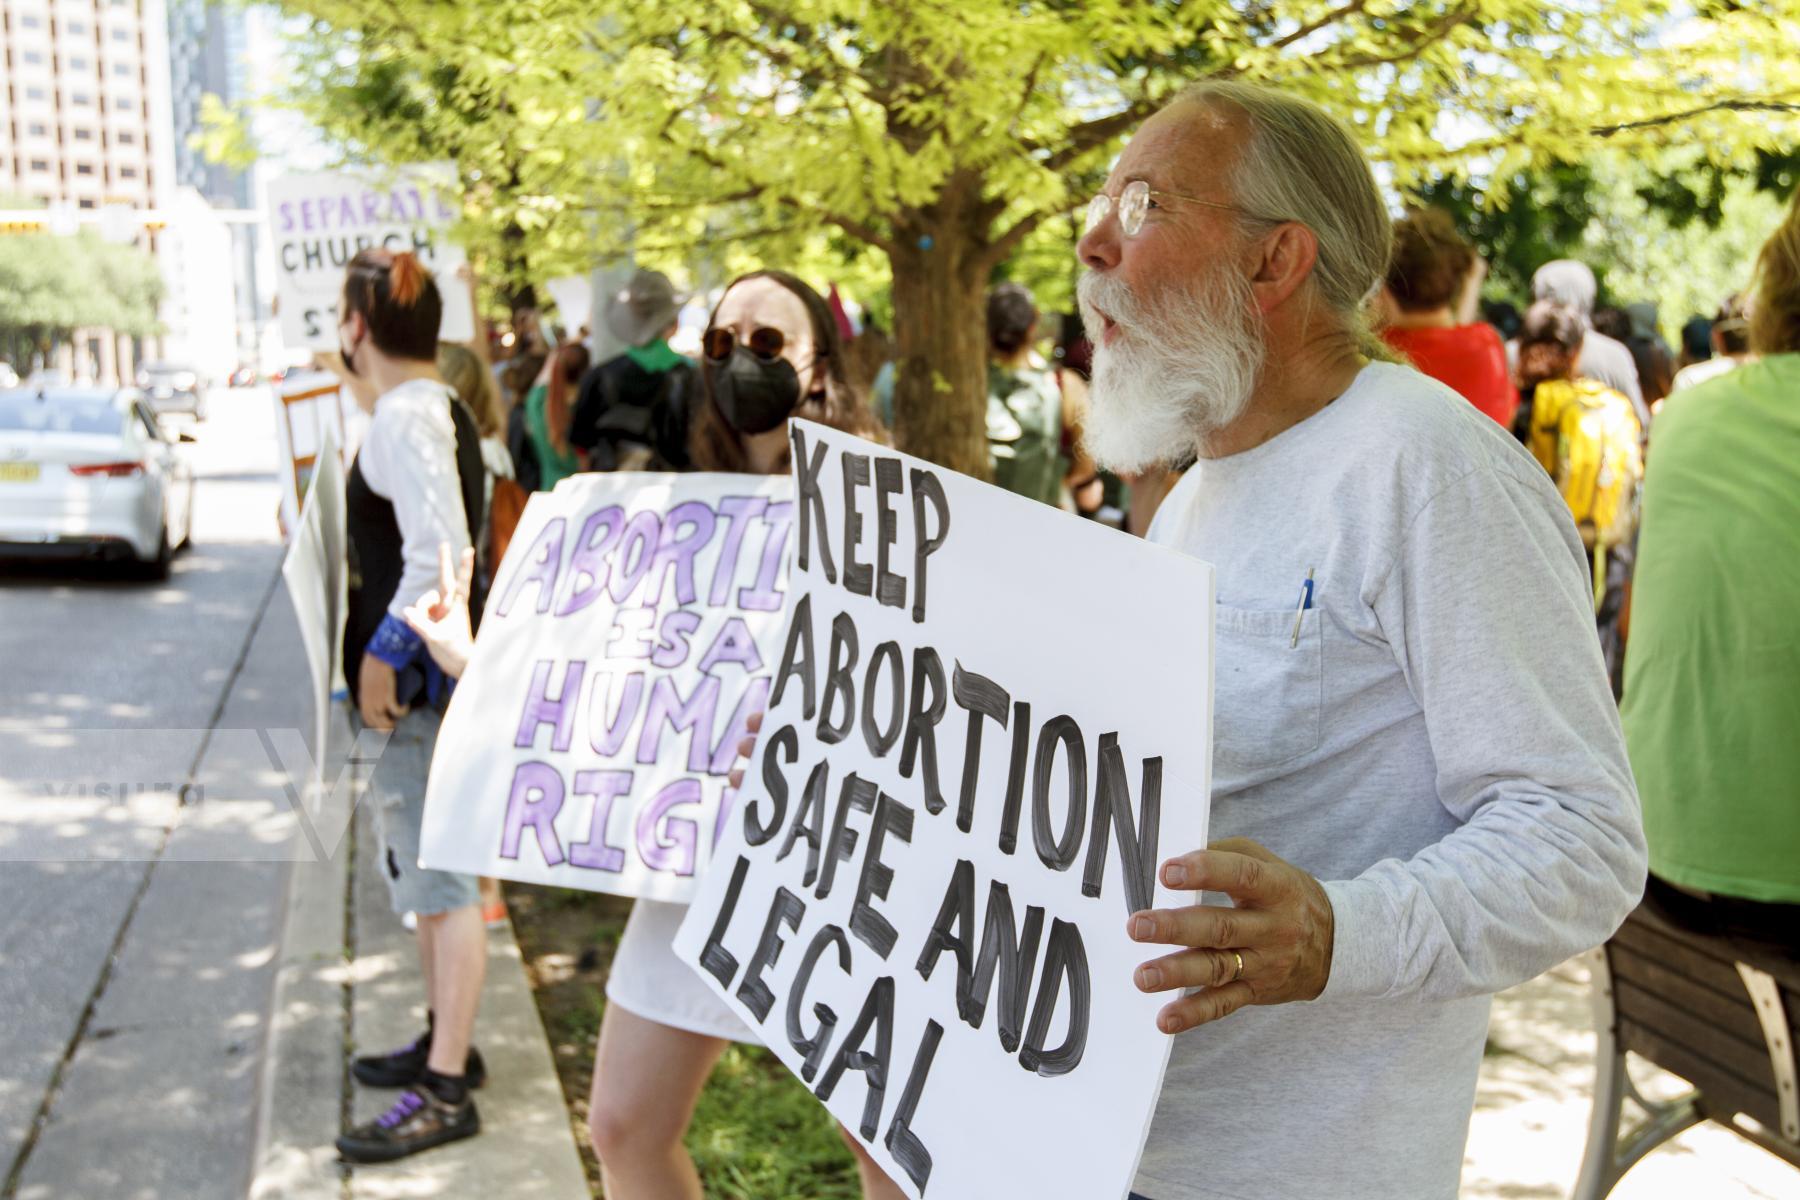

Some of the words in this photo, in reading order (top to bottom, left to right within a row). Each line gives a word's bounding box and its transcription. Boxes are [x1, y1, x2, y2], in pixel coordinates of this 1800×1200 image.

[496, 495, 792, 616] ABORTI
[791, 425, 951, 623] KEEP
[698, 616, 764, 673] A
[499, 760, 740, 877] RIG
[769, 593, 1162, 920] ABORTION
[744, 724, 914, 961] SAFE
[915, 859, 1091, 1078] AND
[699, 855, 944, 1199] LEGAL
